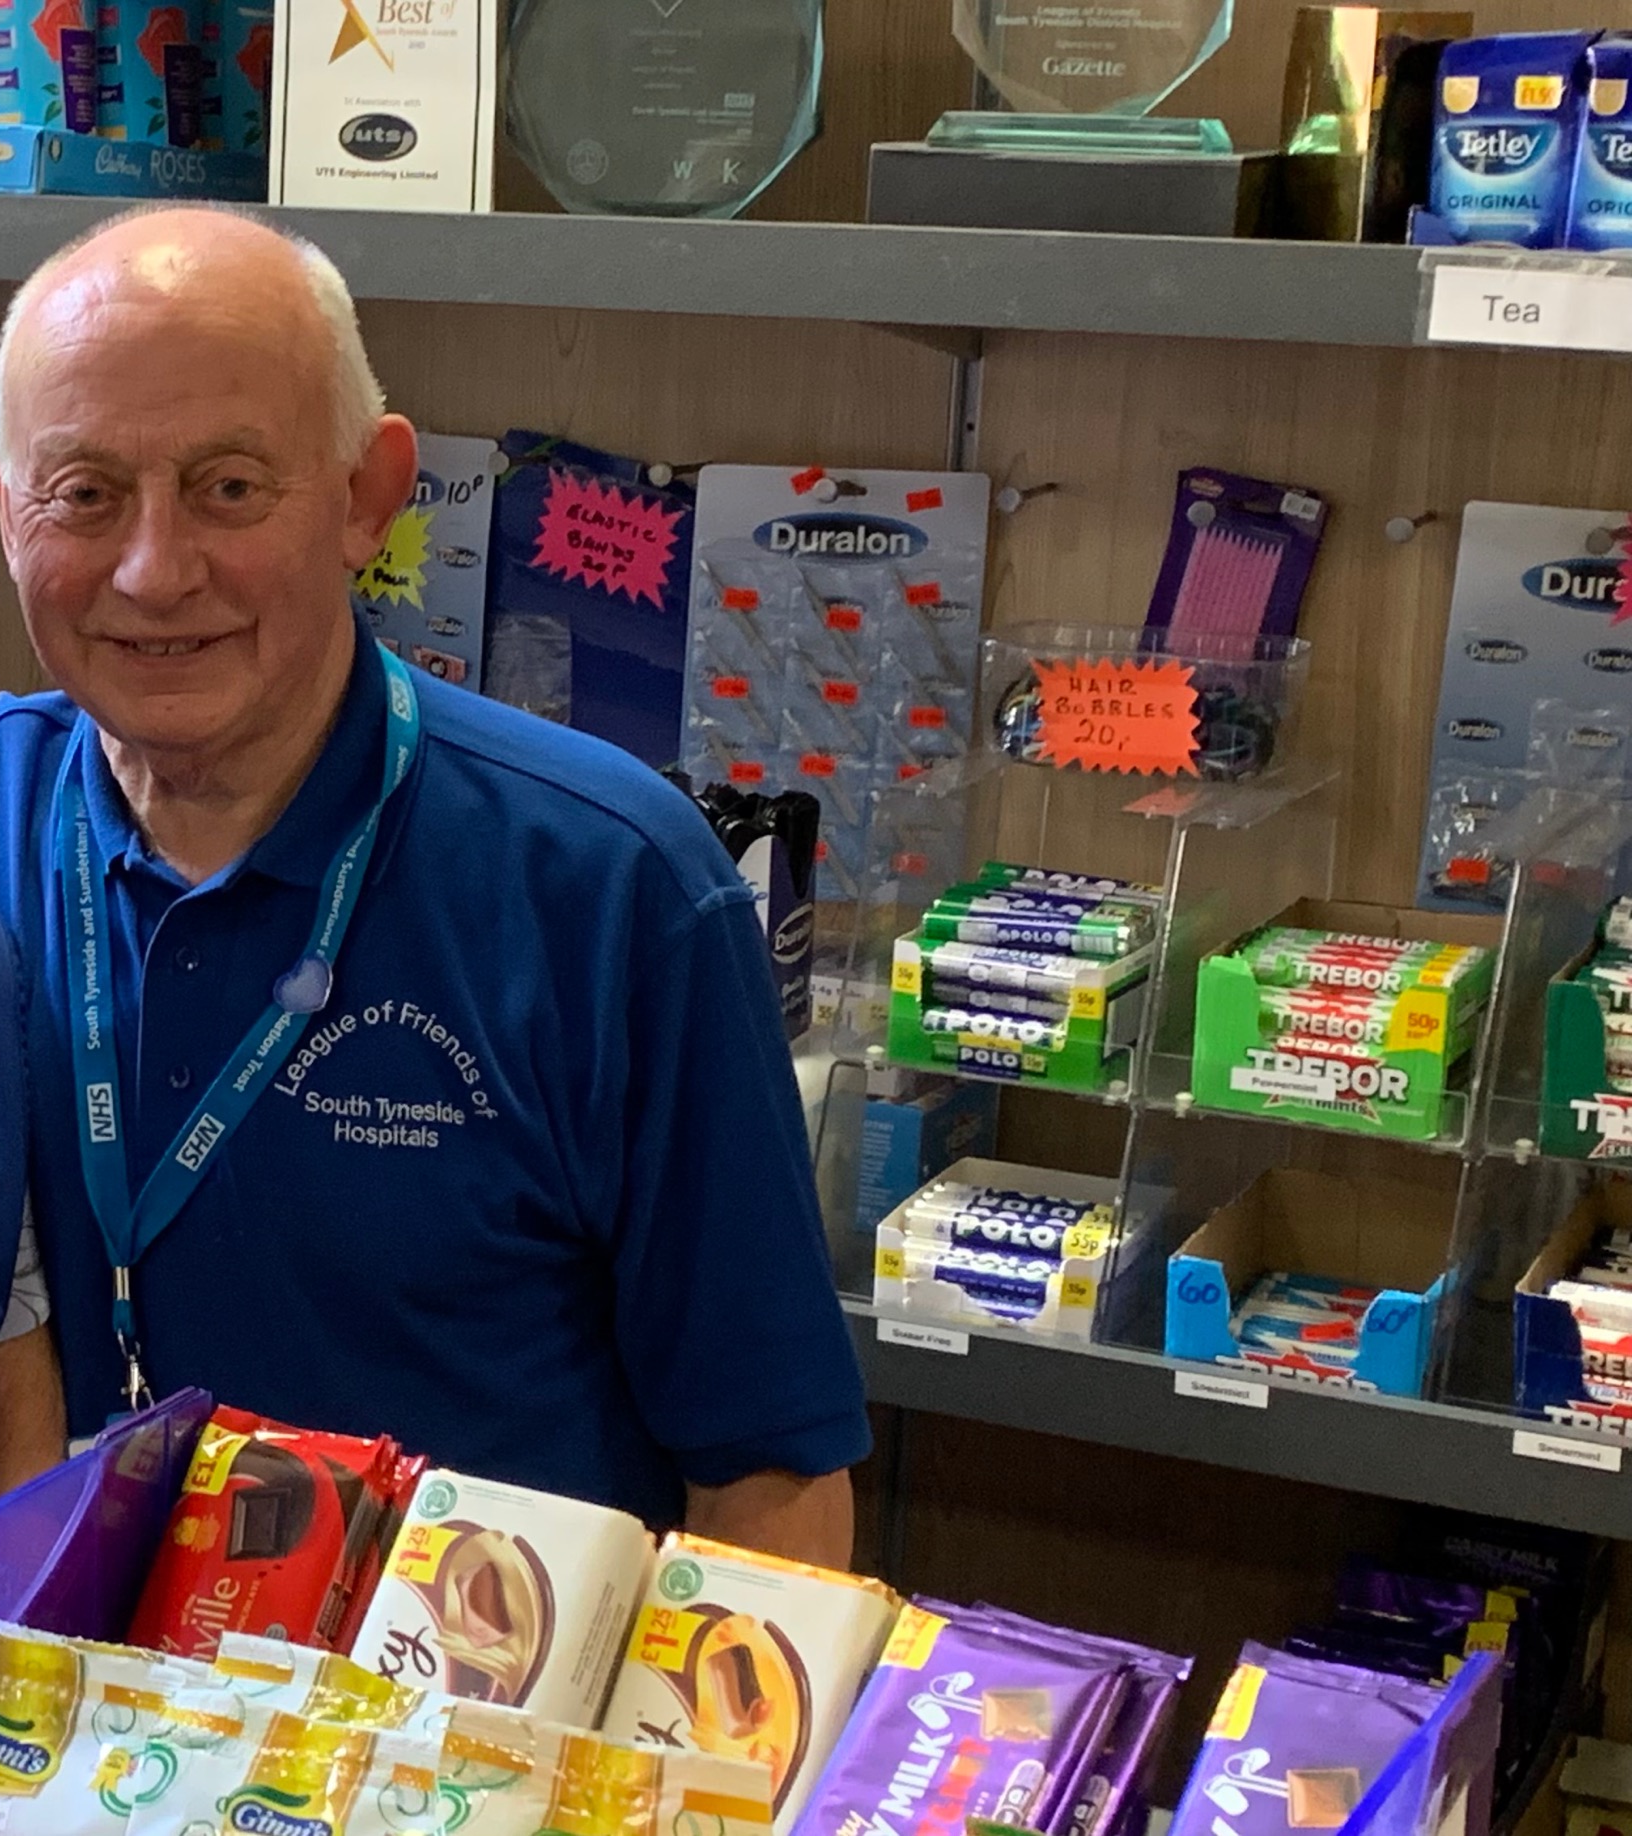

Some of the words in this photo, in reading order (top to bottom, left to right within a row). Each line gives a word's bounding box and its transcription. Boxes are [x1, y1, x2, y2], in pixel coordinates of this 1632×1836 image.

[376, 0, 433, 24] Best
[1042, 56, 1126, 77] Gazette
[1456, 129, 1541, 166] Tetley
[95, 144, 142, 178] Cadbury
[150, 150, 207, 188] ROSES
[338, 168, 397, 180] Engineering
[400, 170, 438, 180] Limited
[1448, 194, 1541, 211] ORIGINAL
[1483, 295, 1541, 324] Tea
[567, 504, 658, 543] ELASTIC
[770, 521, 911, 555] Duralon
[567, 529, 636, 562] BANDS
[1470, 644, 1522, 661] Duralon
[1588, 652, 1632, 668] Duralo
[1070, 678, 1138, 695] HAIR
[1055, 697, 1175, 719] BOBBLES
[1449, 721, 1500, 738] Duralon
[76, 822, 92, 904] Sunderland
[81, 906, 94, 936] and
[1010, 929, 1054, 944] POLO
[82, 940, 100, 1002] Tyneside
[1293, 960, 1402, 992] TREBOR
[86, 1005, 100, 1050] South
[256, 1012, 294, 1058] dation
[1273, 1008, 1384, 1043] TREBOR
[1408, 1012, 1439, 1031] 50p
[274, 1014, 357, 1096] League
[363, 1000, 394, 1024] of
[399, 1002, 481, 1084] Friends
[472, 1091, 499, 1119] of
[960, 1047, 1018, 1067] POLO
[233, 1059, 264, 1092] Trust
[1246, 1049, 1409, 1101] TREBOR
[1252, 1077, 1318, 1094] Peppermint
[87, 1082, 116, 1142] NHS
[305, 1092, 371, 1117] South
[375, 1098, 466, 1125] Tyneside
[176, 1112, 226, 1171] NHS
[334, 1120, 439, 1148] Hospitals
[955, 1215, 1058, 1249] POLO
[1070, 1233, 1099, 1251] 55p
[1178, 1271, 1220, 1304] 60
[927, 1334, 953, 1347] Free
[1191, 1381, 1250, 1400] Spearmint
[1538, 1442, 1602, 1462] Spearmint
[394, 1526, 432, 1577] £1.25
[640, 1607, 679, 1663] £1.25
[878, 1728, 954, 1819] MILK
[235, 1802, 330, 1836] Ginni's
